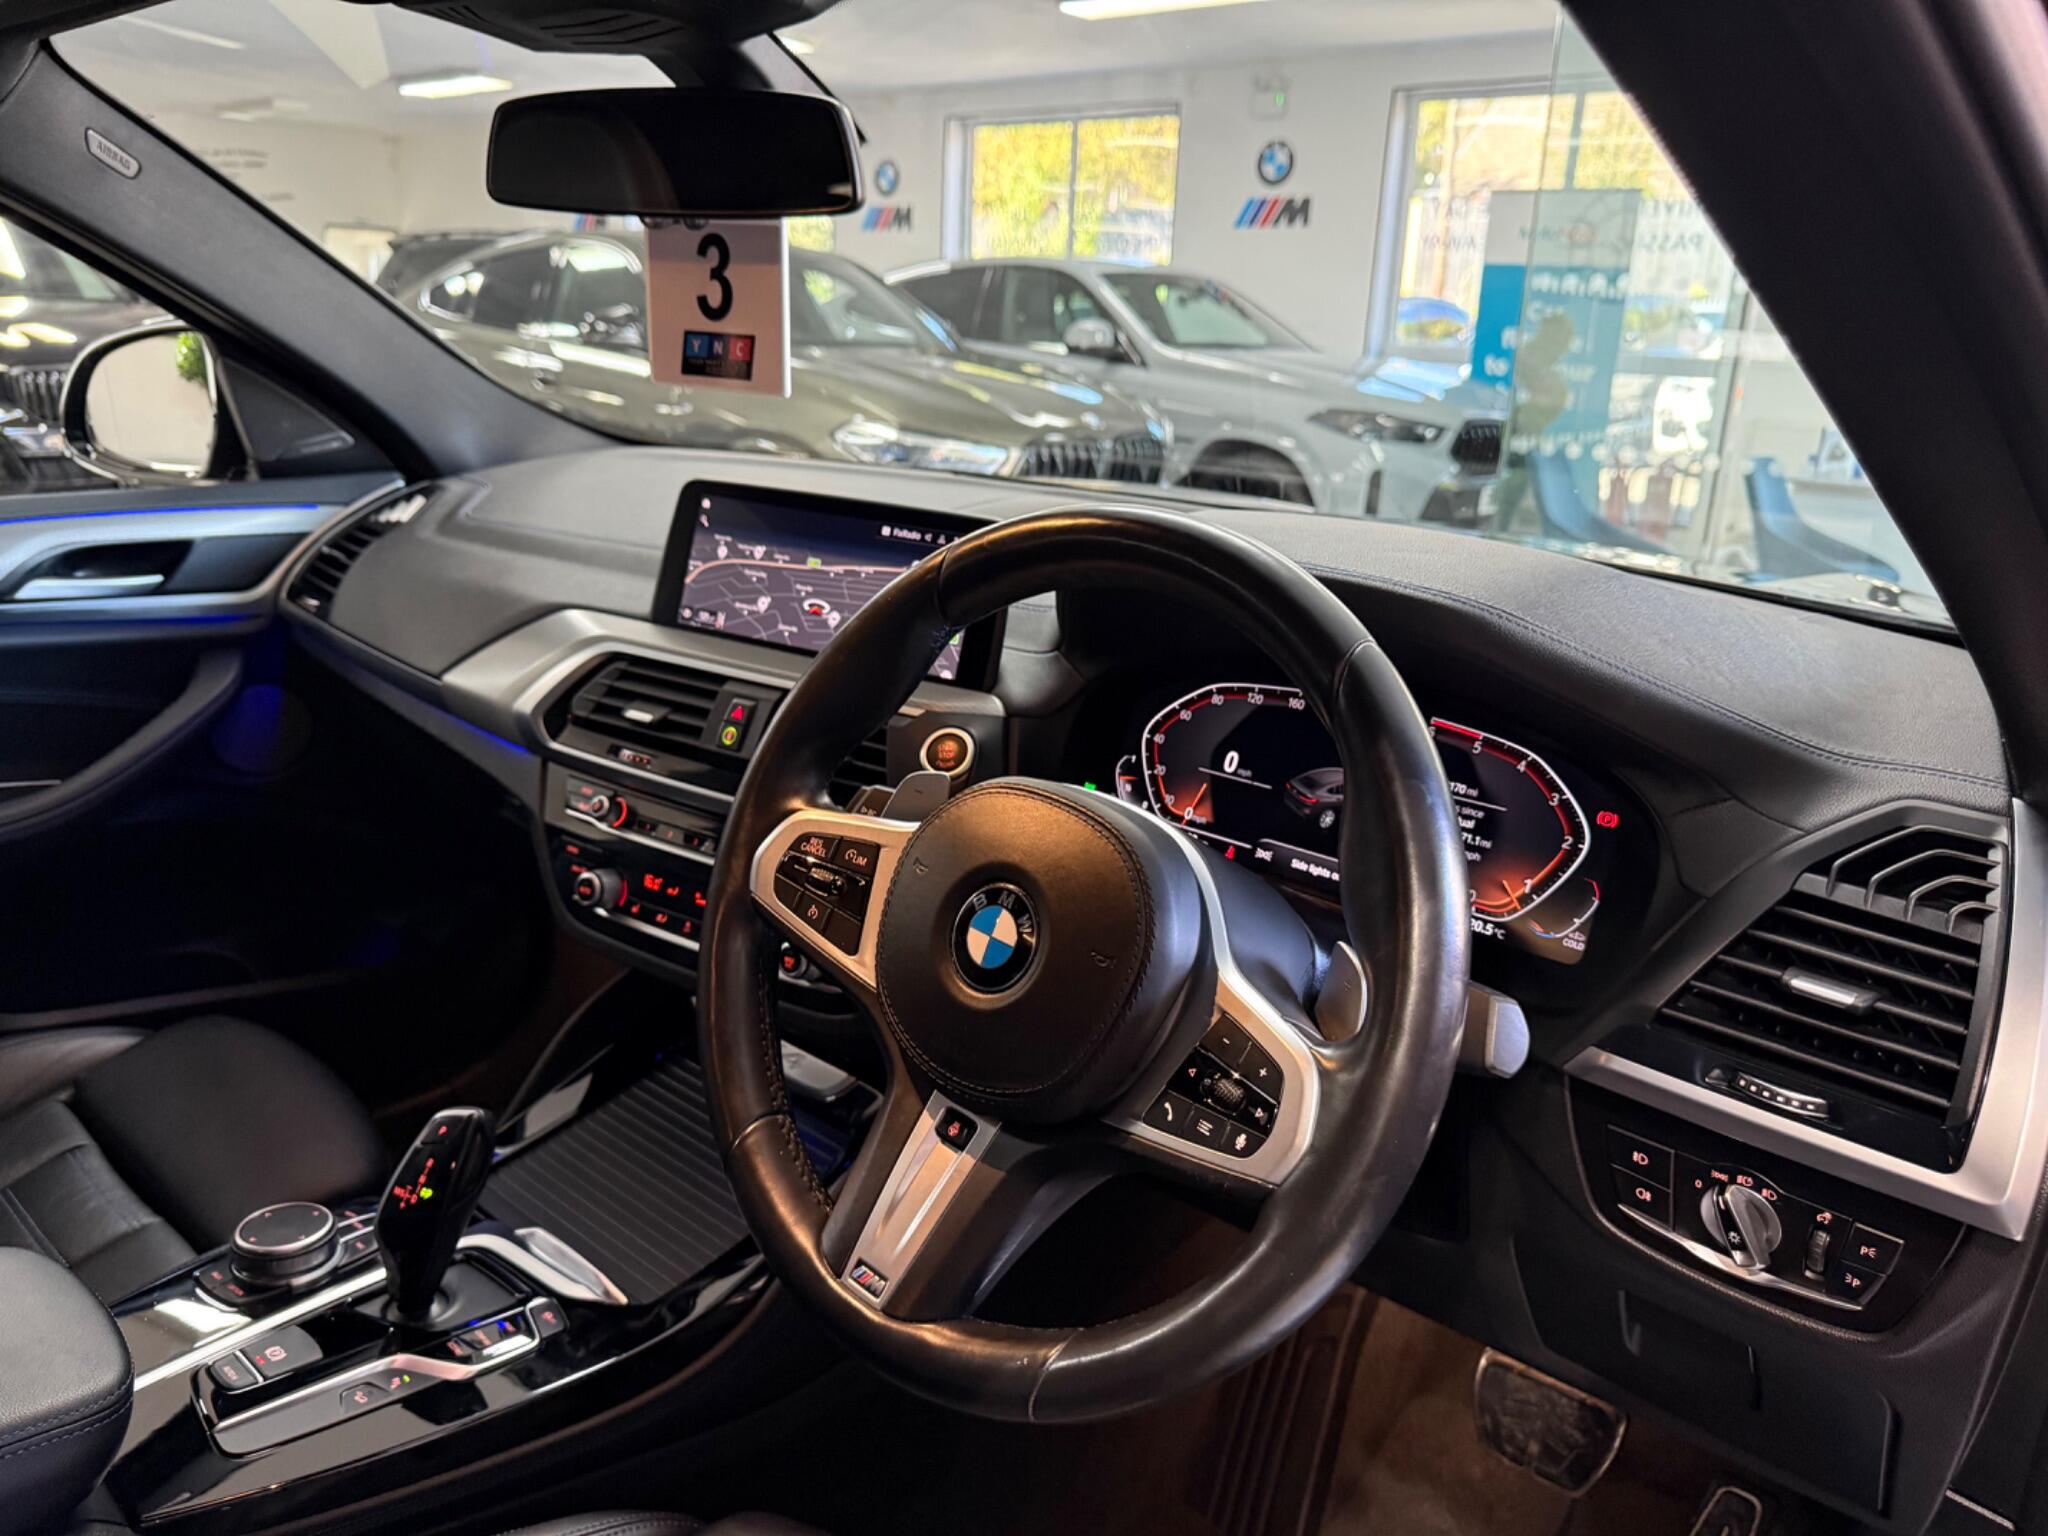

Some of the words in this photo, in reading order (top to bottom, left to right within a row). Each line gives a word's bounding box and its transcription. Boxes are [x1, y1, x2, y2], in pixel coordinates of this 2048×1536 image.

[696, 232, 734, 322] 3
[1211, 694, 1224, 706] 80
[1247, 692, 1264, 705] 120
[1288, 698, 1305, 710] 160
[1179, 709, 1192, 721] 60
[1153, 732, 1165, 744] 40
[1472, 740, 1483, 754] 5
[1223, 750, 1239, 774] 0
[1516, 759, 1527, 773] 4
[1154, 764, 1166, 776] 20
[1548, 792, 1560, 806] 3
[1562, 836, 1574, 849] 2
[801, 842, 827, 858] CANCEL
[1291, 858, 1309, 872] Side
[1308, 863, 1331, 877] lights
[1523, 878, 1533, 894] 1
[972, 889, 1034, 936] BMW
[1562, 938, 1585, 951] COLD
